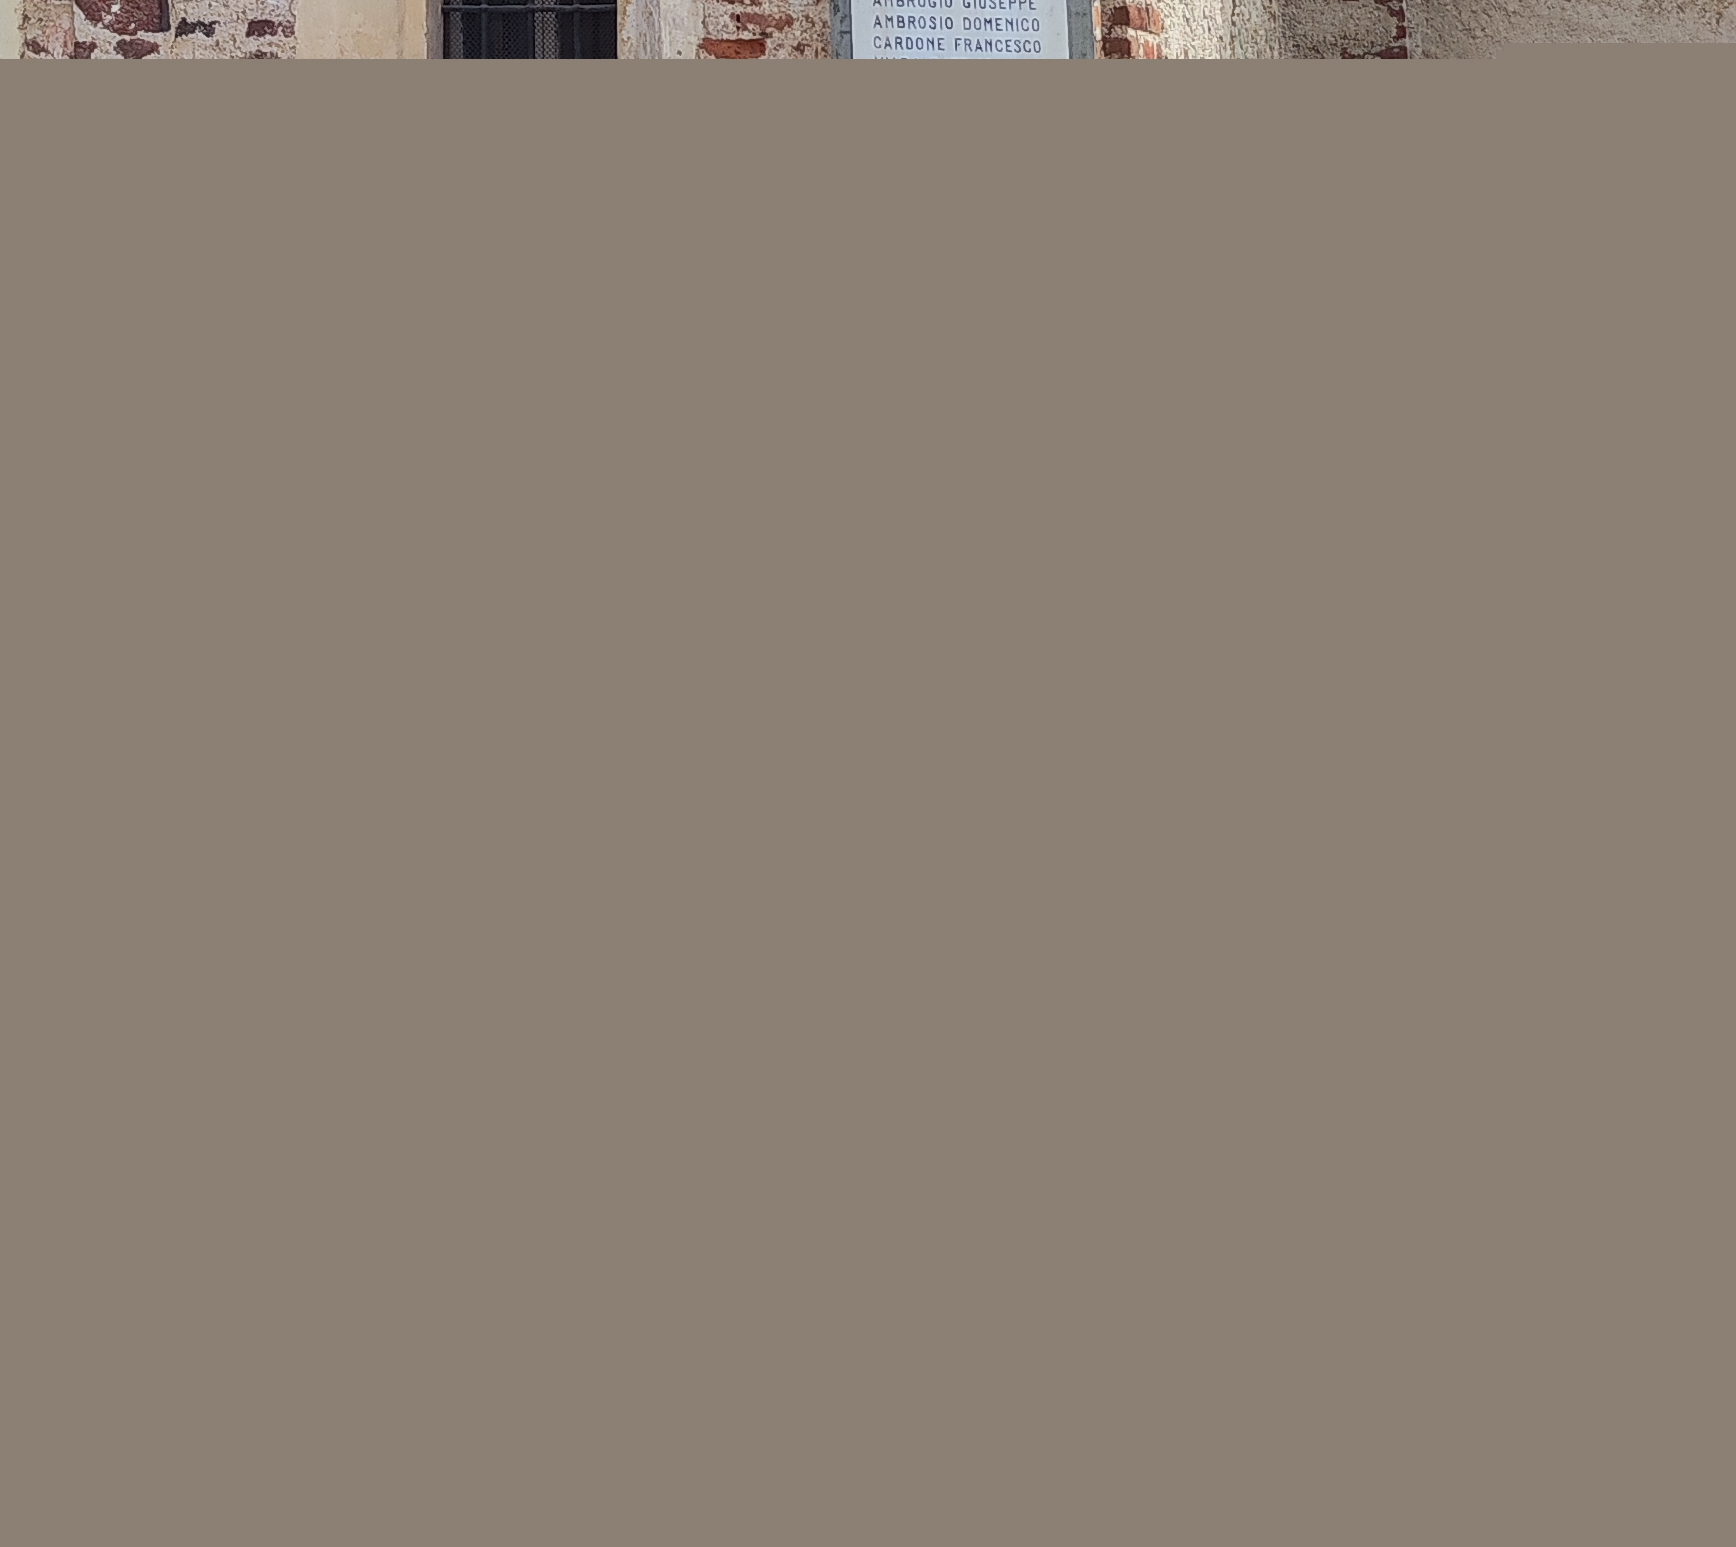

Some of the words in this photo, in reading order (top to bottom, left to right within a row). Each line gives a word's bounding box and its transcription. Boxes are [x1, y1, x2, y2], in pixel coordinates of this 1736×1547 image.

[872, 14, 954, 30] AMBROSIO
[962, 17, 1040, 32] DOMENICO
[873, 35, 946, 51] CARDONE
[954, 37, 1042, 54] FRANCESCO
